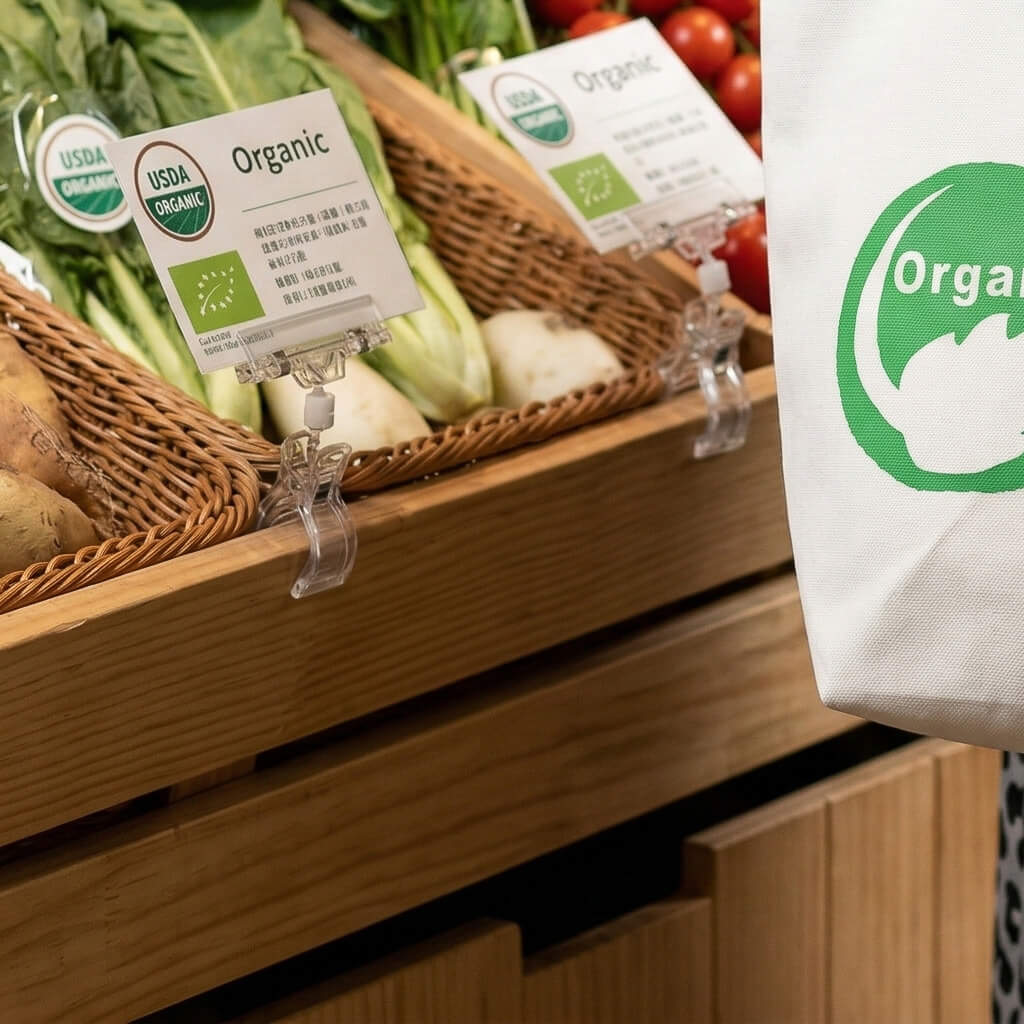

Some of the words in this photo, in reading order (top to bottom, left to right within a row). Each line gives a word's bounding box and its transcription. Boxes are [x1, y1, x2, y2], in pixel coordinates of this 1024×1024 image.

[572, 53, 661, 93] Organic
[59, 146, 108, 170] USDA
[231, 129, 330, 174] Organic
[147, 164, 191, 191] USDA
[154, 191, 204, 216] ORGANIC
